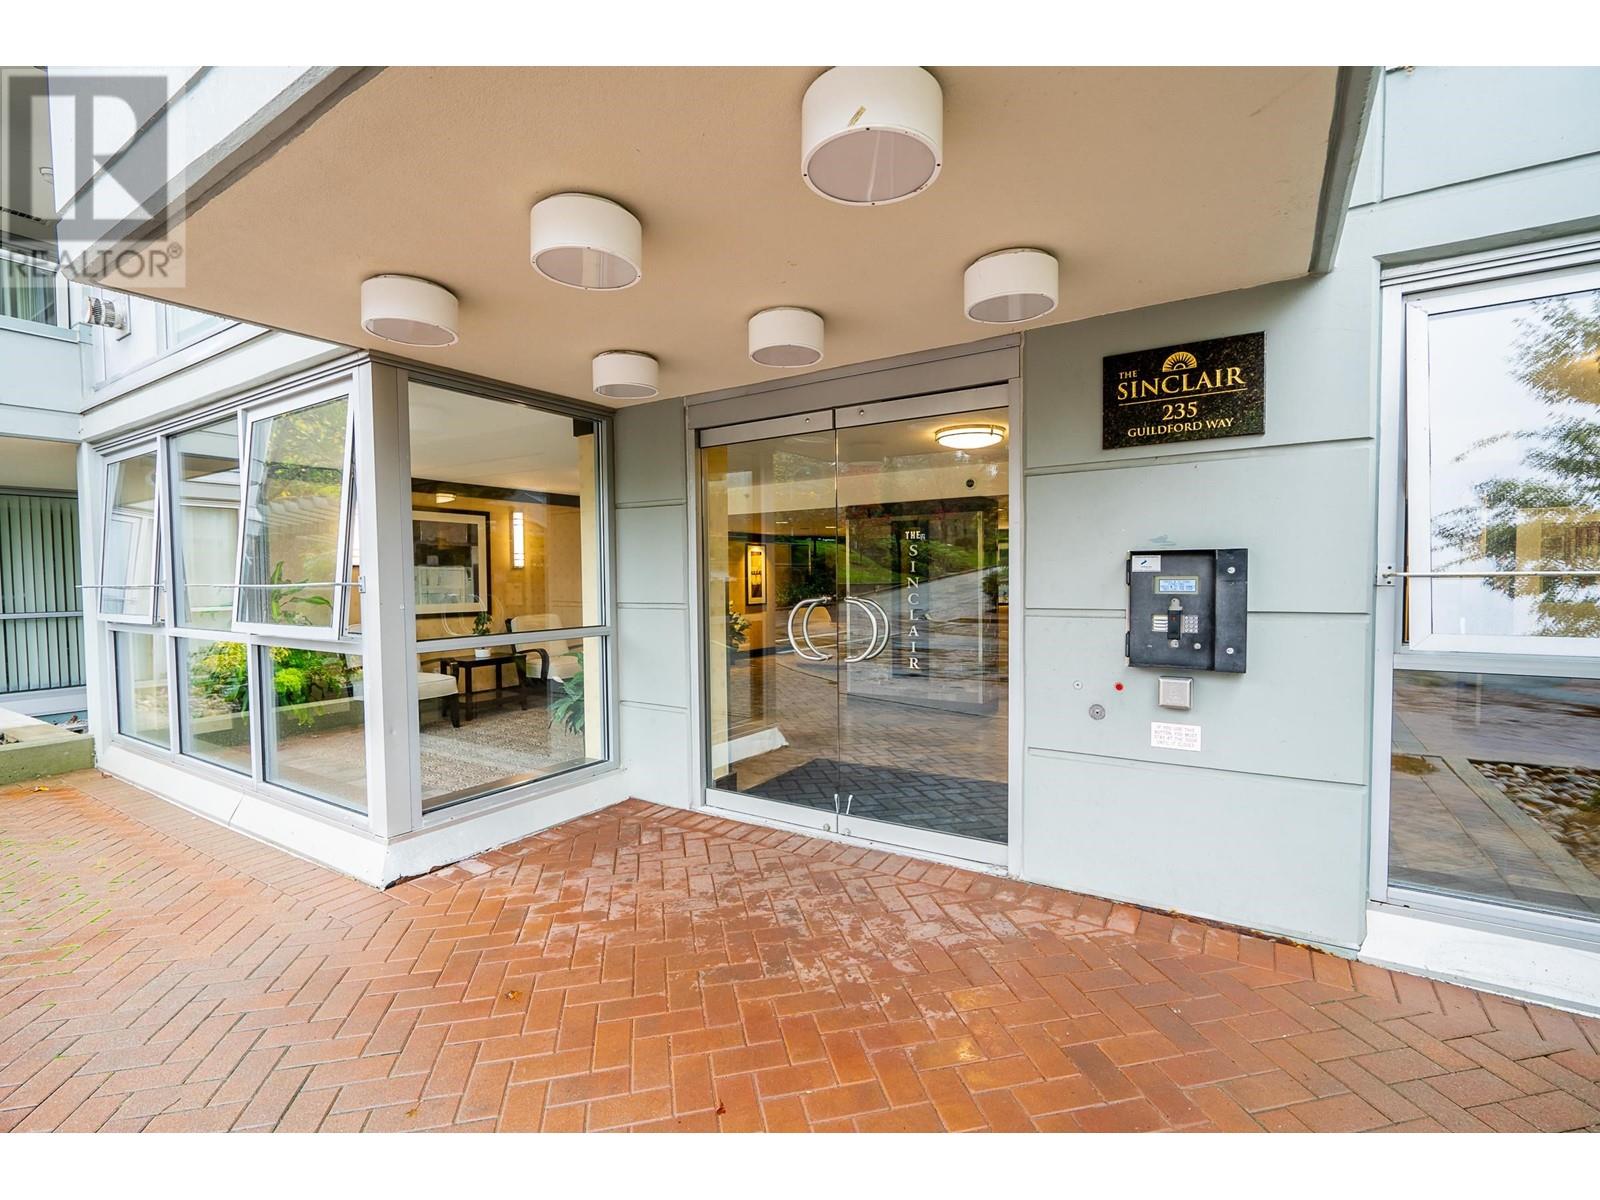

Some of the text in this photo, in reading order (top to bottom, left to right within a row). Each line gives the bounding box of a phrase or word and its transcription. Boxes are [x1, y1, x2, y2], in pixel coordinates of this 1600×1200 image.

[1117, 366, 1247, 400] SINCLAIR
[1118, 370, 1138, 379] THE
[1162, 401, 1198, 421] 235
[1127, 417, 1235, 438] GUILDFORD WAY
[905, 530, 921, 540] THE
[906, 544, 920, 670] SINCLAIR
